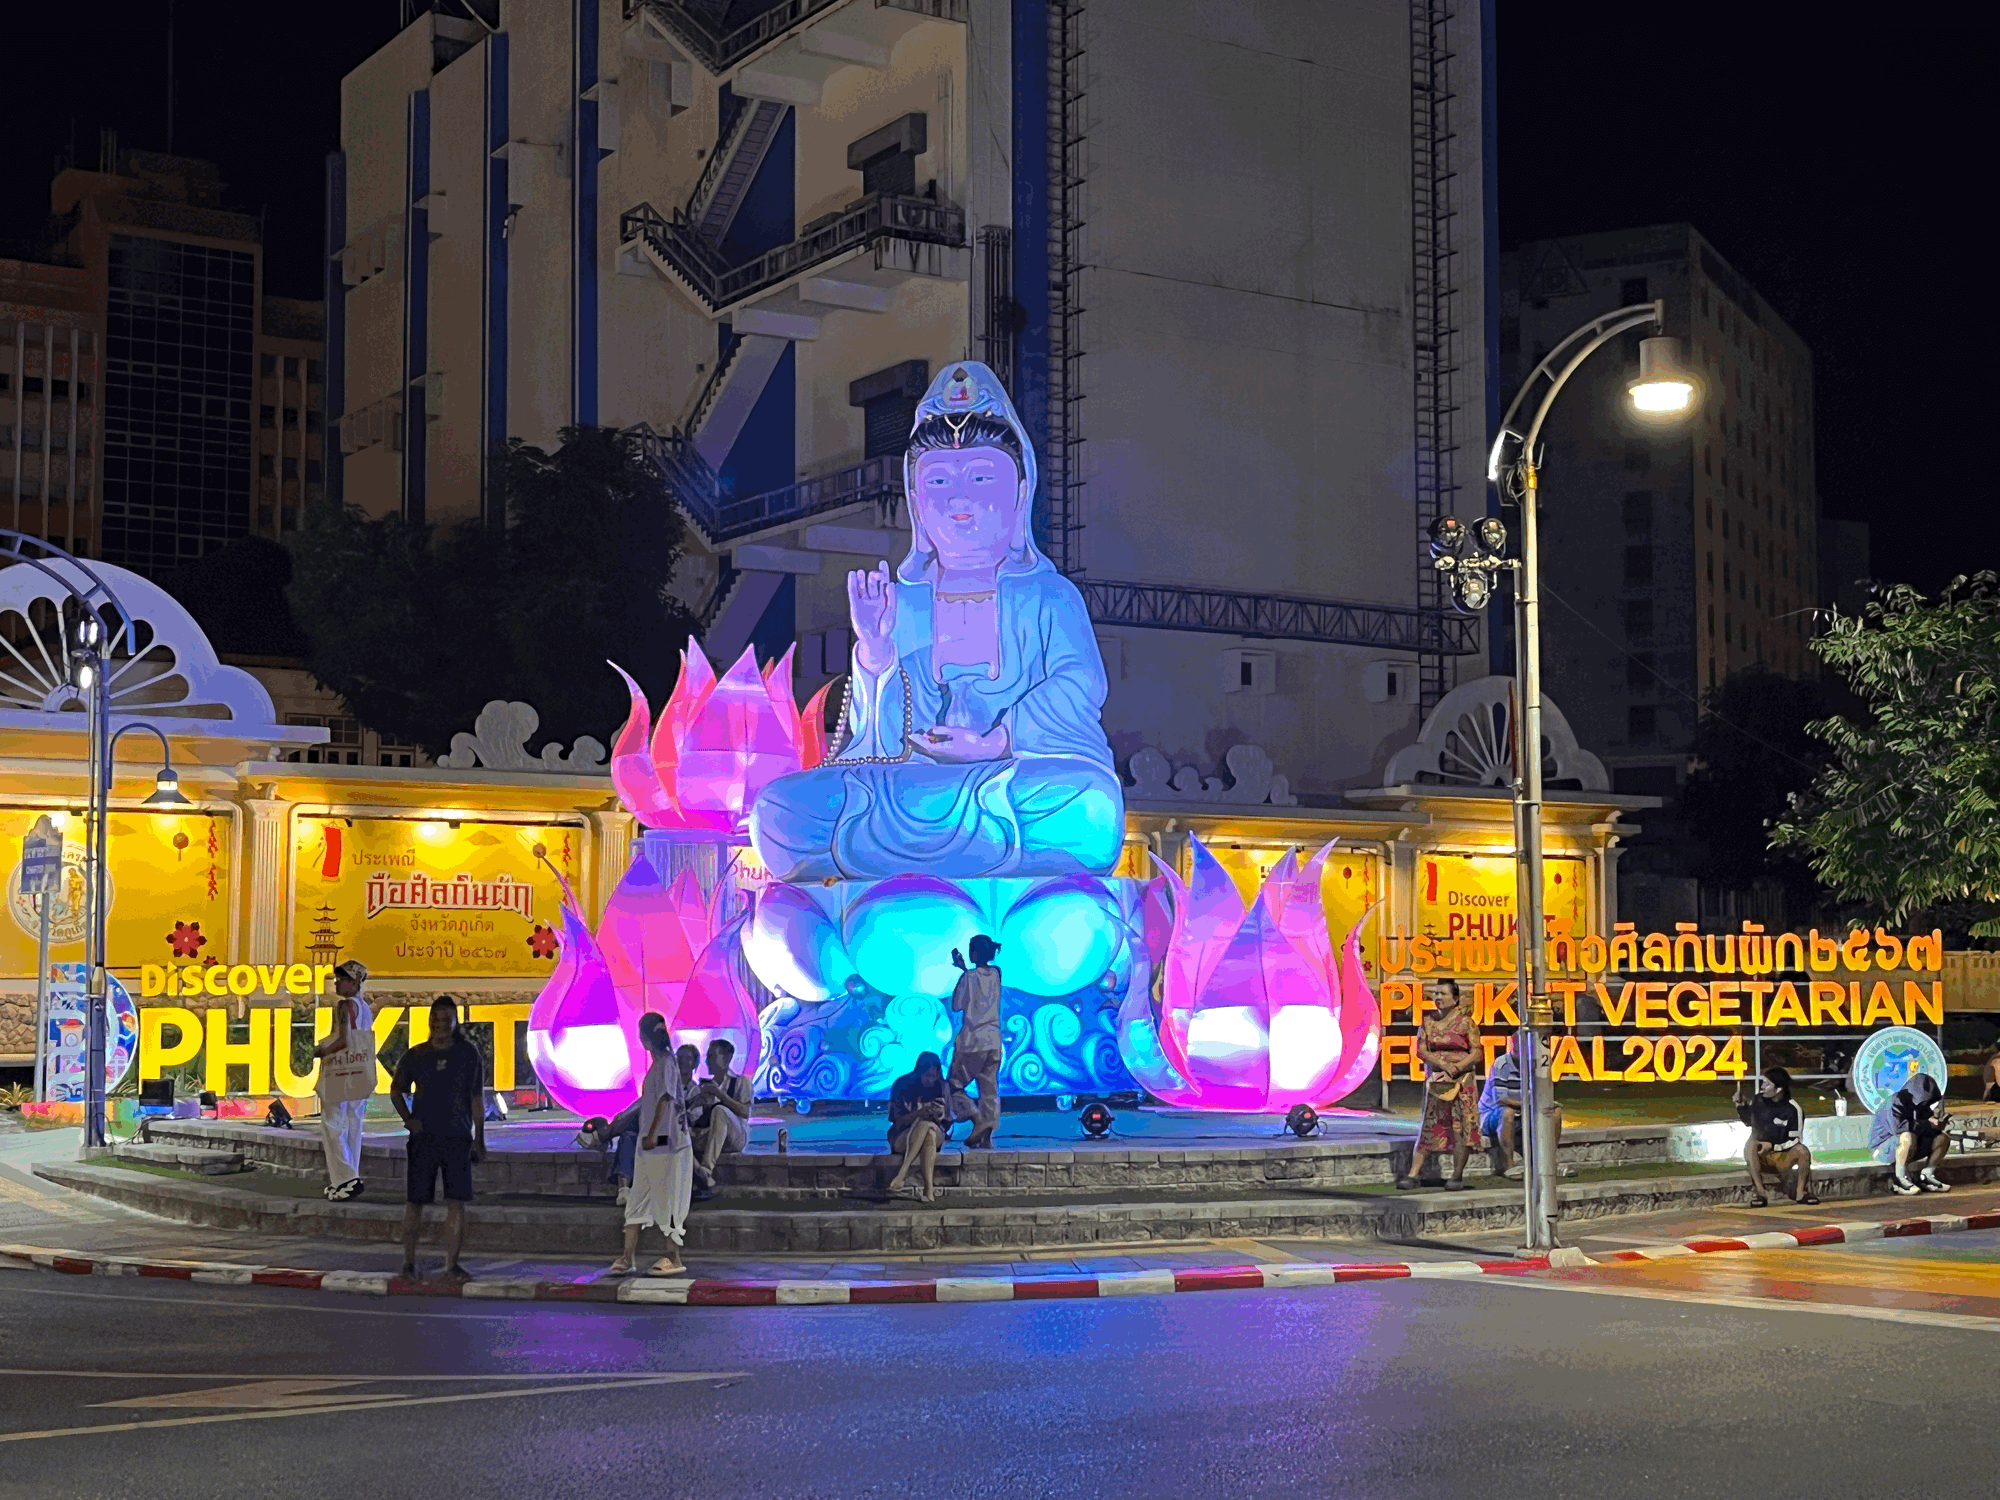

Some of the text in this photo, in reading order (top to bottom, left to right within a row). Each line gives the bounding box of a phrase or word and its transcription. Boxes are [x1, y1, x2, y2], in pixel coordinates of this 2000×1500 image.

[352, 848, 416, 867] ประเพณี
[1448, 890, 1510, 908] Discover
[410, 913, 494, 937] จังหวัดภูเก็ต
[396, 941, 508, 959] ประจำปี ๒๕๖๗
[140, 961, 334, 997] Discover
[1593, 981, 1944, 1028] VEGETARIAN
